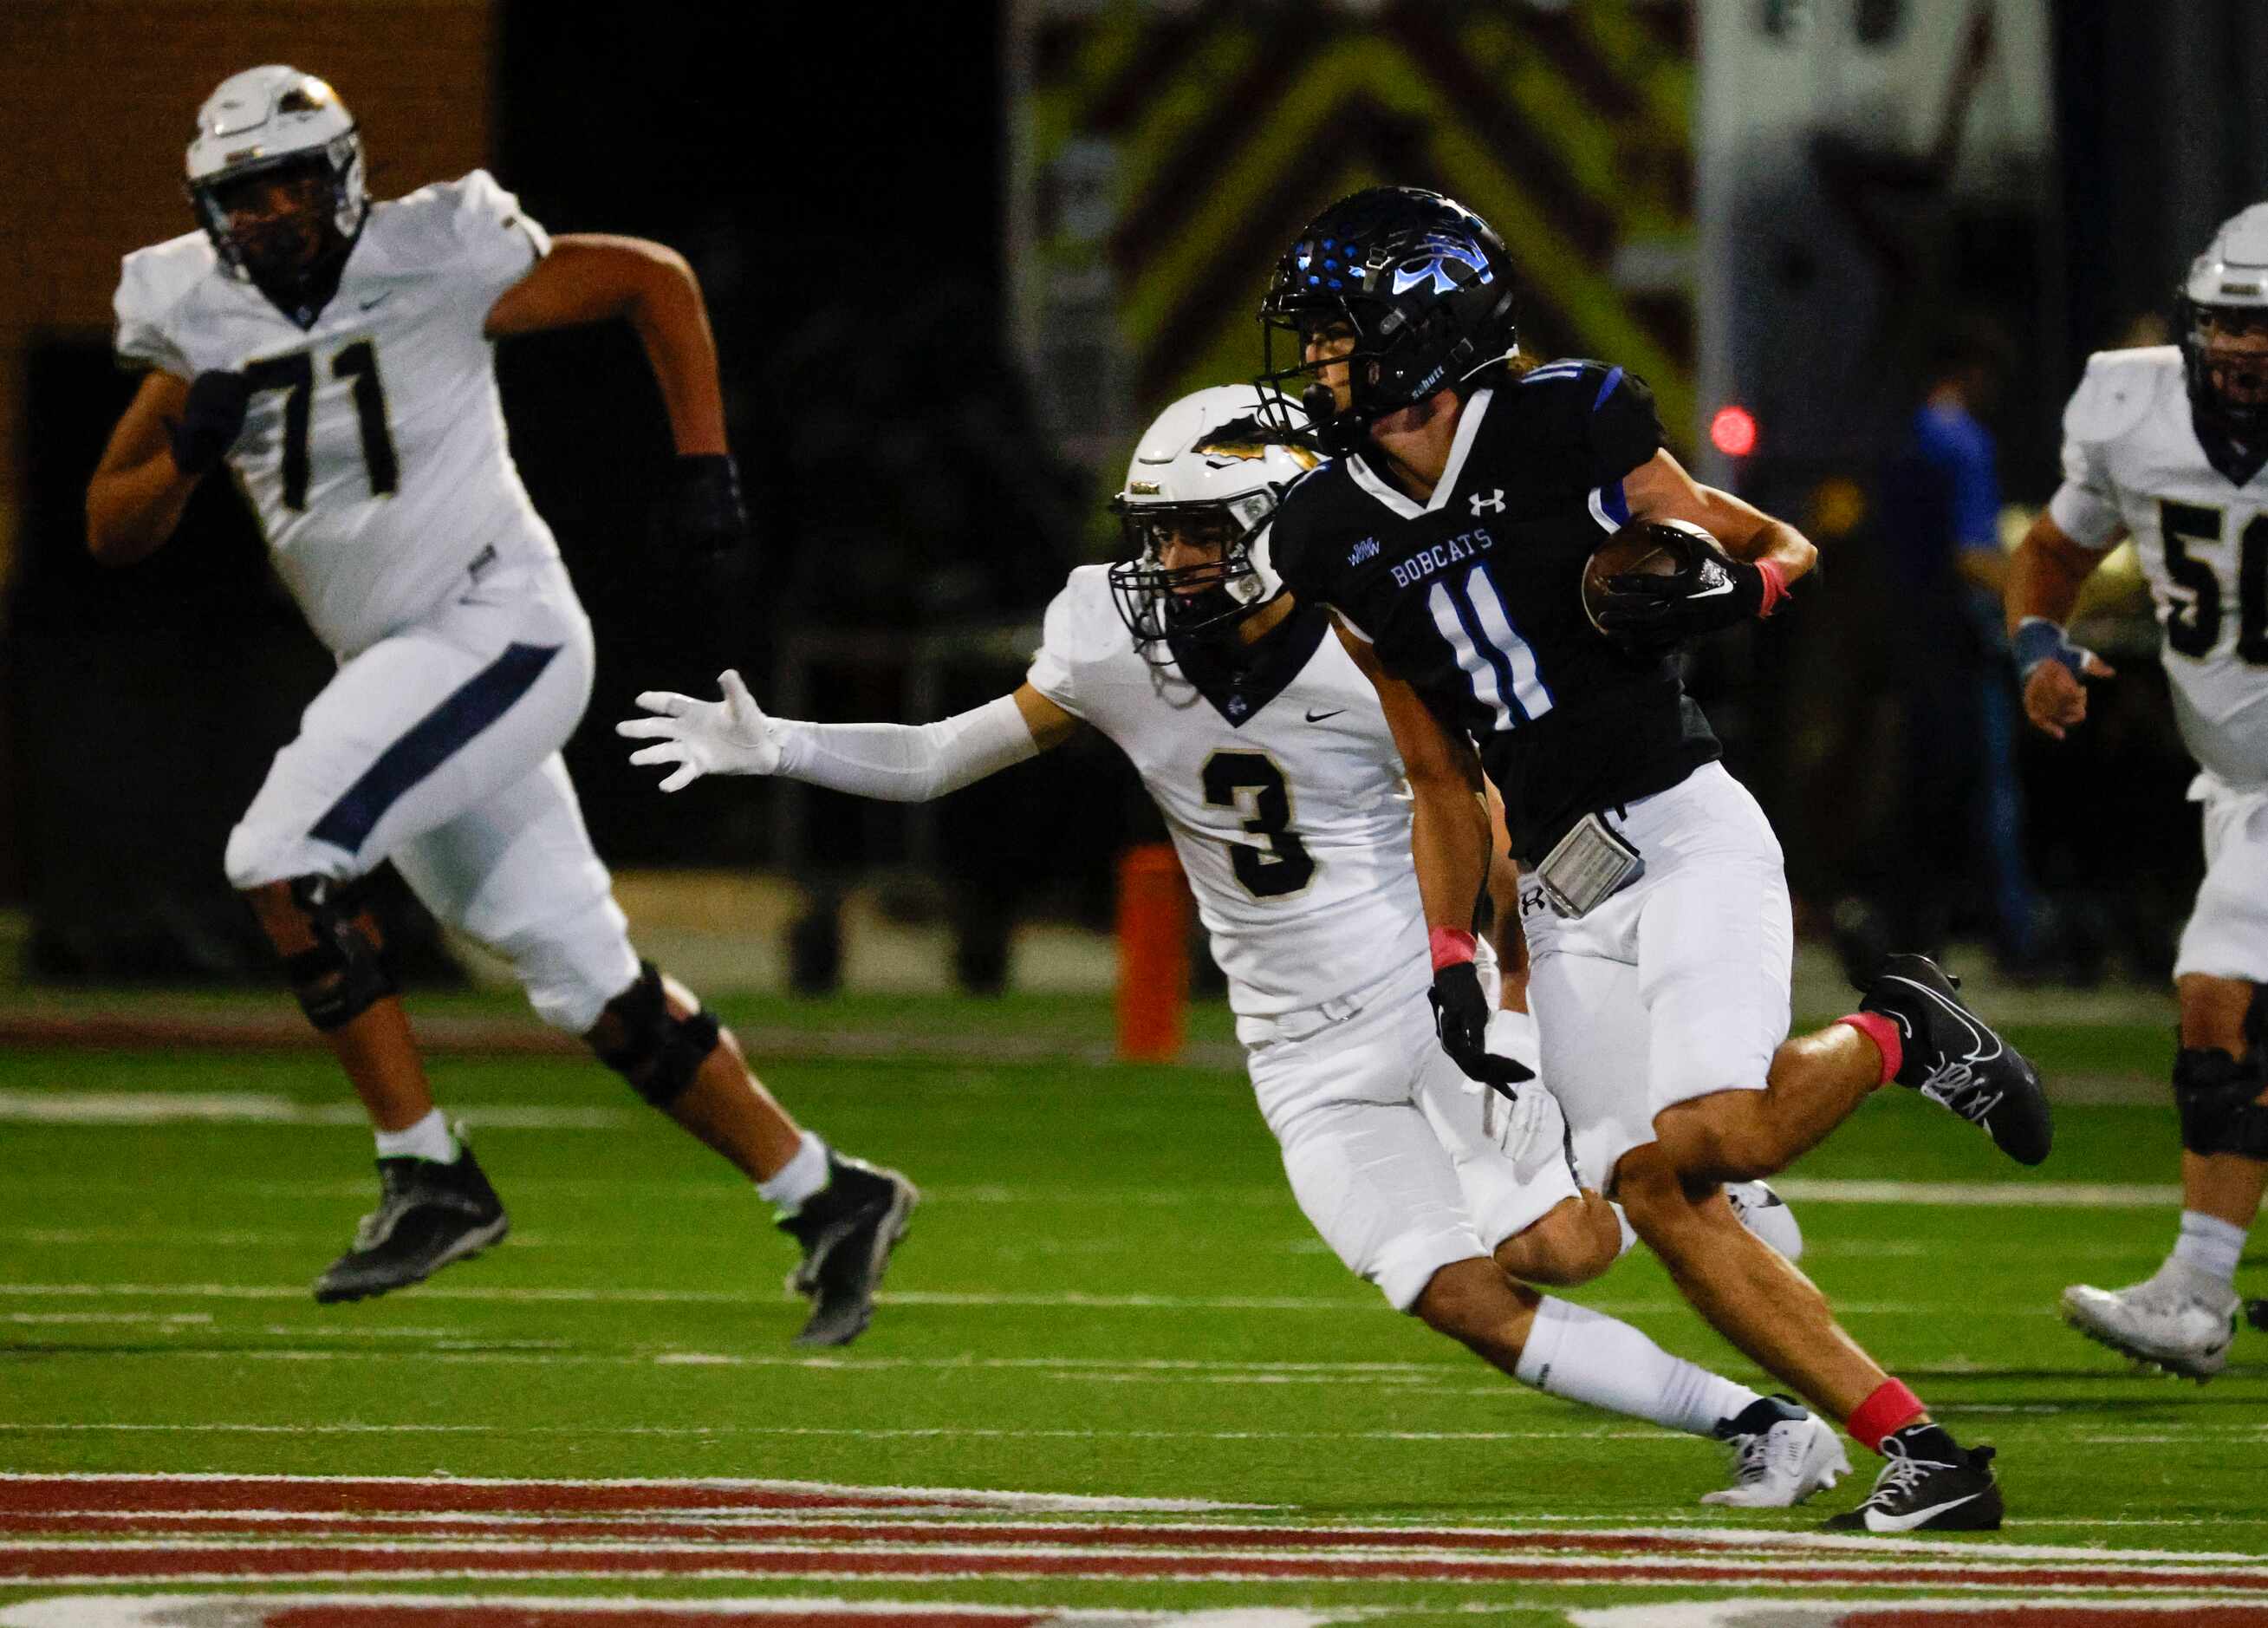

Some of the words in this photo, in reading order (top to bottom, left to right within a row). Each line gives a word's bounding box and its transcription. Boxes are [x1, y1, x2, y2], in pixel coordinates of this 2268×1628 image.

[243, 337, 399, 511] 71
[1390, 528, 1492, 588] BOBCATS
[1428, 563, 1554, 732] 11
[1201, 749, 1316, 901] 3
